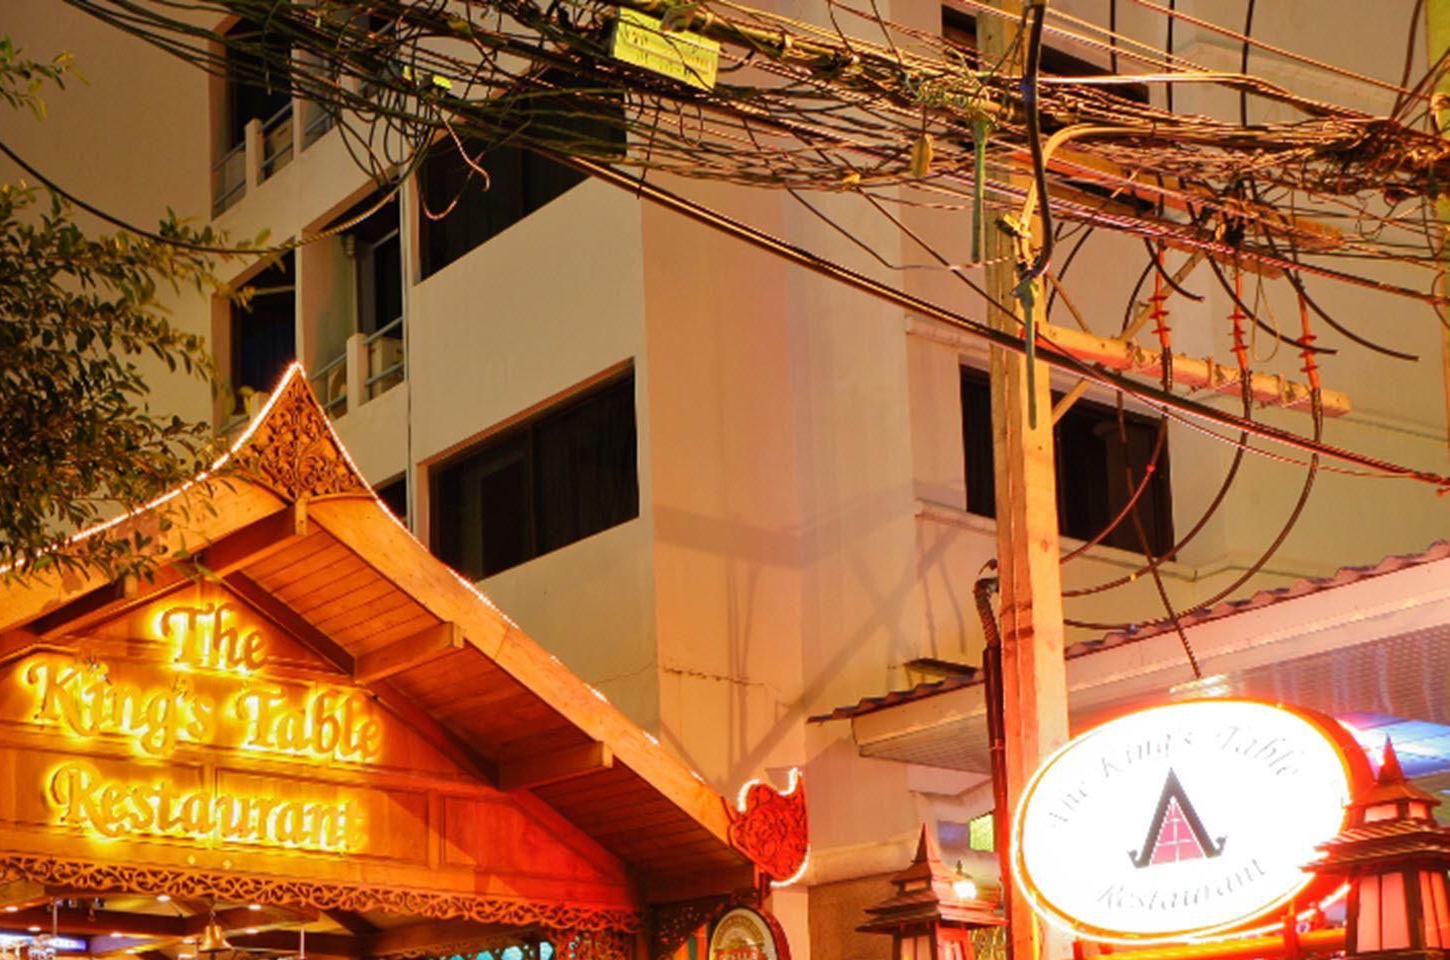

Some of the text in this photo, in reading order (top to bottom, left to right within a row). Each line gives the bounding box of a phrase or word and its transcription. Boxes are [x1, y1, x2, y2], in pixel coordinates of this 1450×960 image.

[159, 602, 270, 670] The
[24, 660, 383, 762] King's Table
[1216, 723, 1307, 777] Table
[47, 763, 366, 852] Restaurant
[1095, 855, 1267, 912] Restaurant
